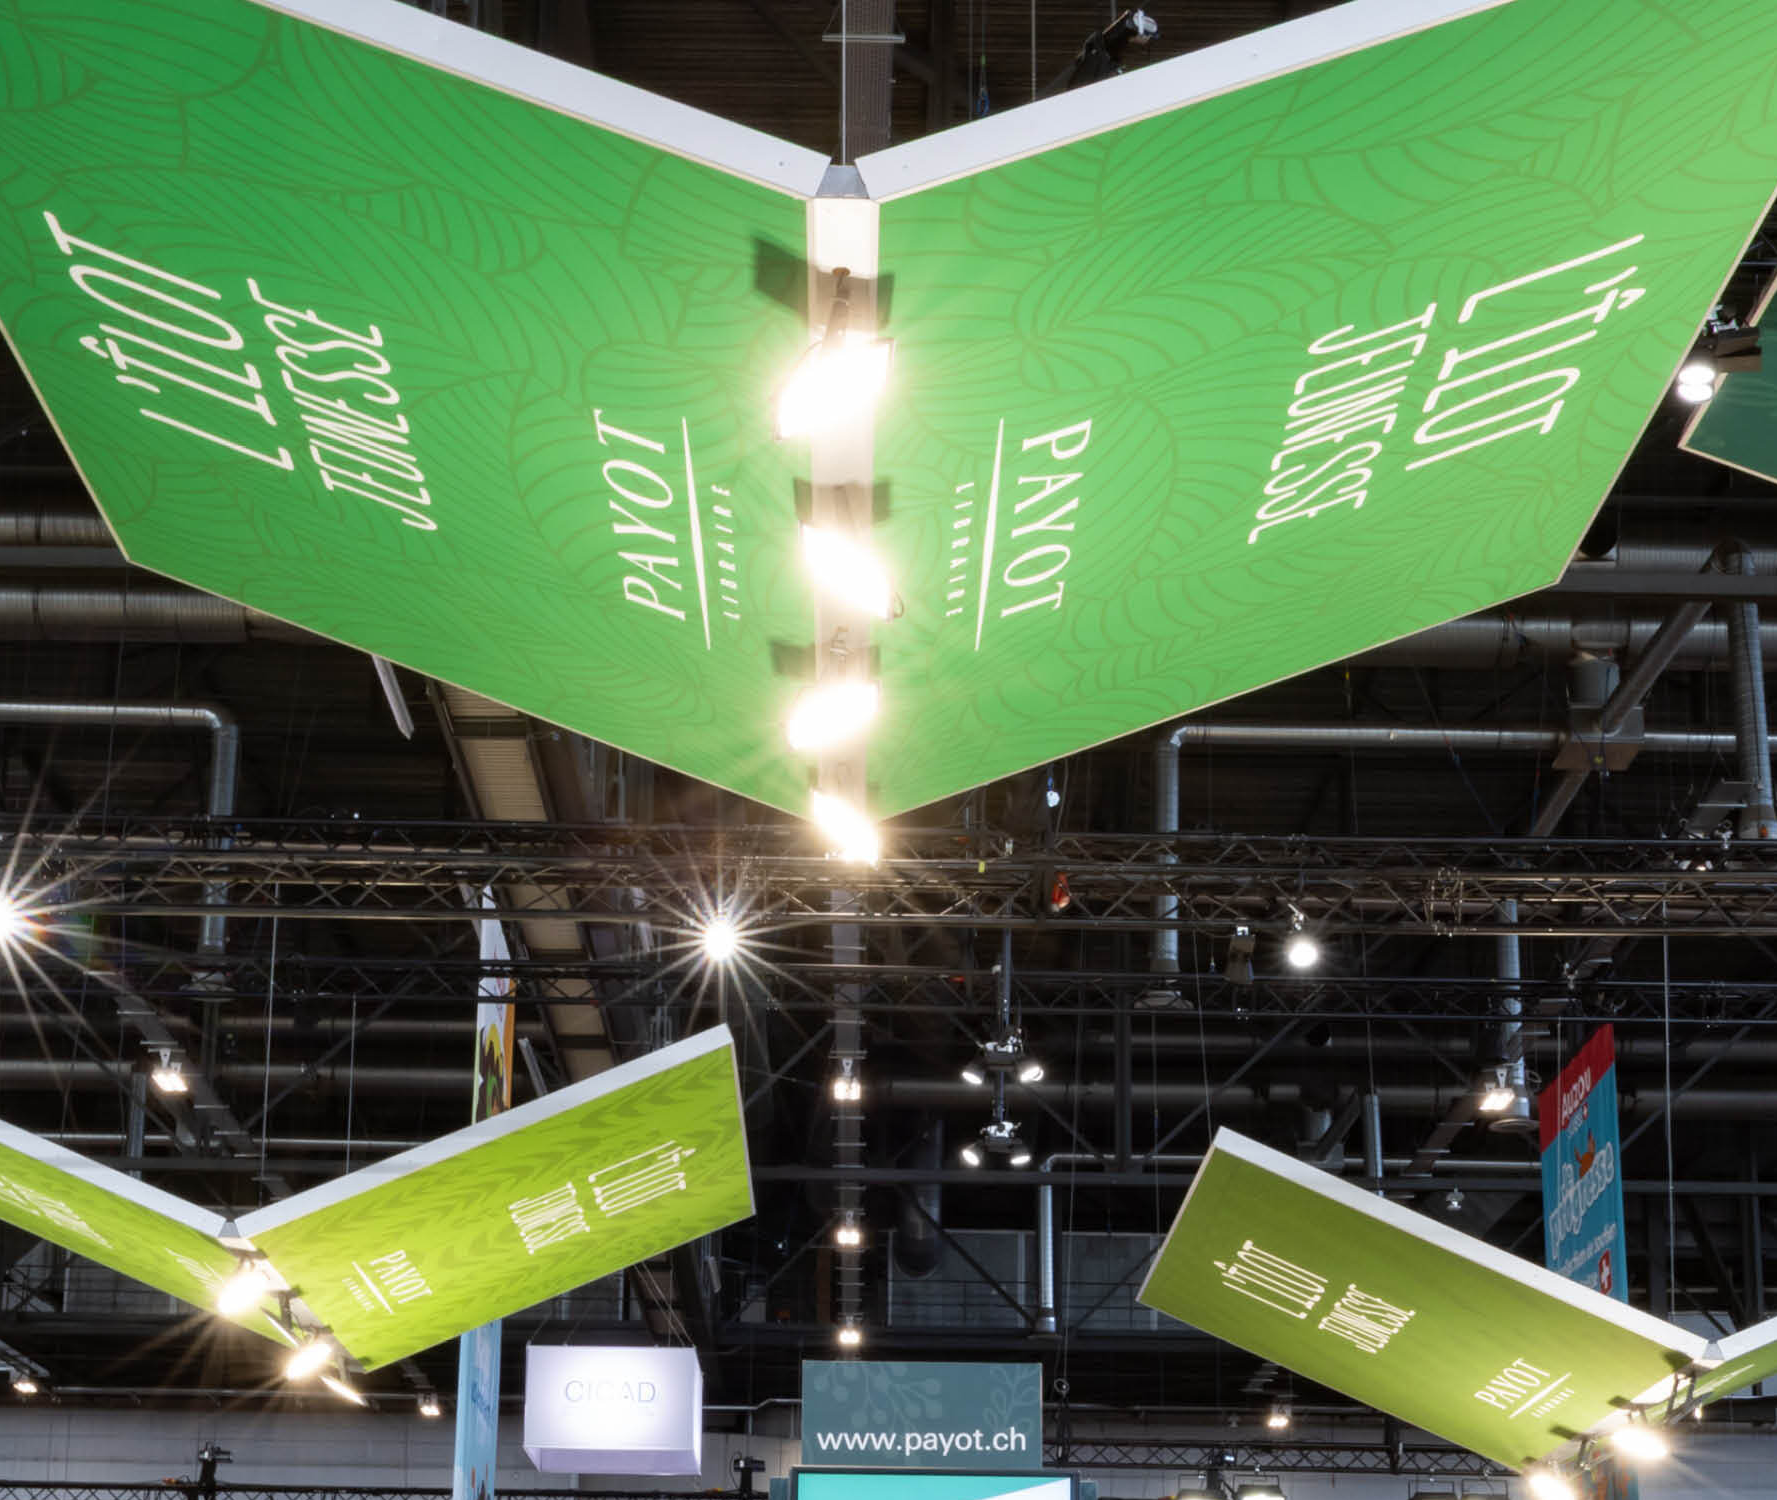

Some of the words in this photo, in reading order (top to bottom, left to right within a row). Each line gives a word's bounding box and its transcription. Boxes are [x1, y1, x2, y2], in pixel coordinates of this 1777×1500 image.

[43, 211, 295, 474] L'ÎLOT
[248, 277, 440, 530] JEUNESSE
[1246, 301, 1437, 545] JEUNESSE
[1404, 233, 1645, 473] L'ÎLOT
[593, 408, 688, 623] PAYOT
[1001, 419, 1092, 620] PAYOT
[369, 1249, 433, 1304] PAYOT
[1474, 1358, 1550, 1410] PAYOT
[817, 1428, 1027, 1457] www.payot.ch
